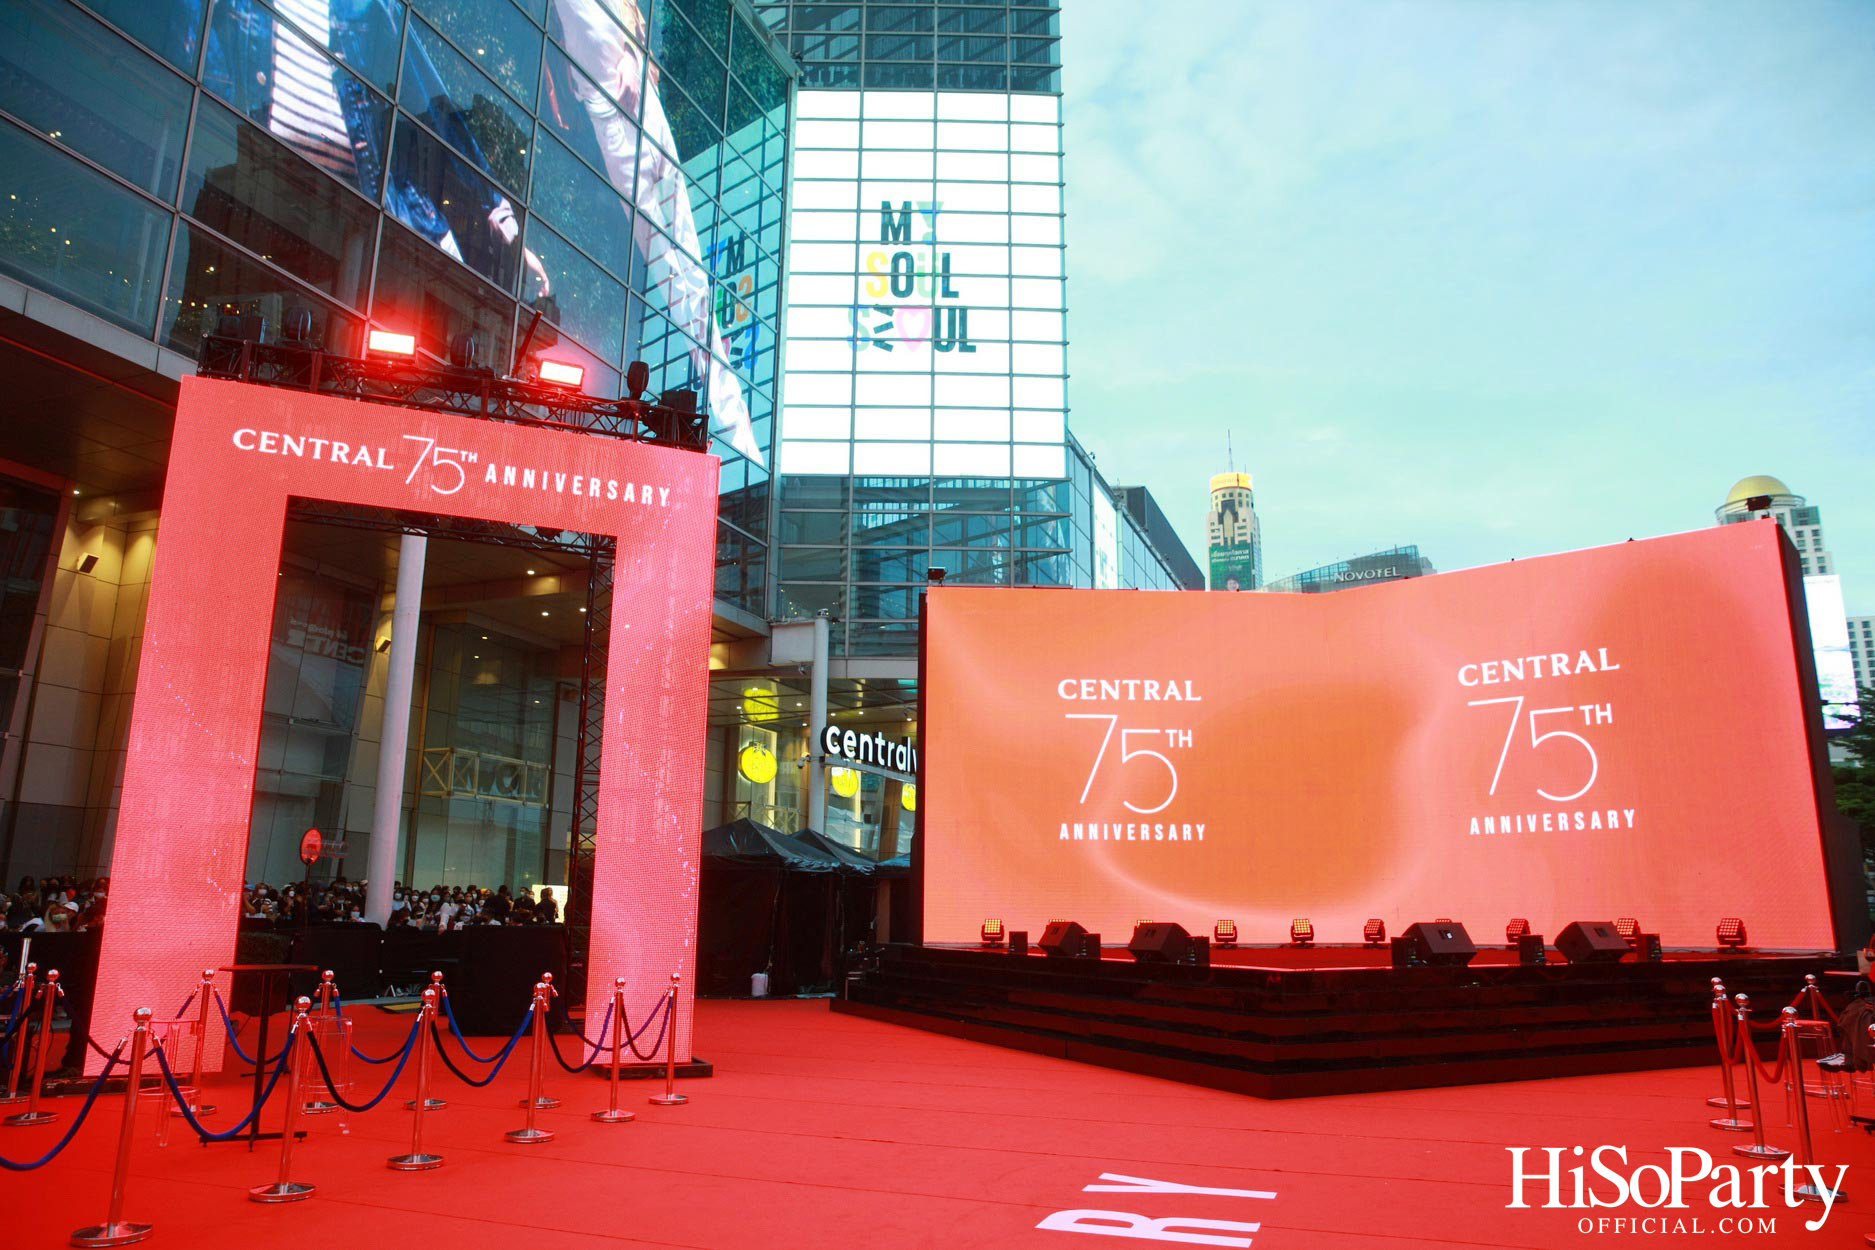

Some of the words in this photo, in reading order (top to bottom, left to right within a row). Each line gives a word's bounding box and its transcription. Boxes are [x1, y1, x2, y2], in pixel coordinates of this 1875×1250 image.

[232, 428, 394, 470] CENTRAL
[403, 435, 478, 494] 75TH
[485, 463, 672, 507] ANNIVERSARY
[1334, 566, 1400, 583] NOVOTEL
[1458, 648, 1620, 686] CENTRAL
[1058, 679, 1201, 701] CENTRAL
[825, 726, 917, 773] central
[1065, 714, 1192, 814] 75TH
[1467, 696, 1613, 801] 75TH
[1060, 823, 1205, 841] ANNIVERSARY
[1470, 809, 1635, 835] ANNIVERSARY
